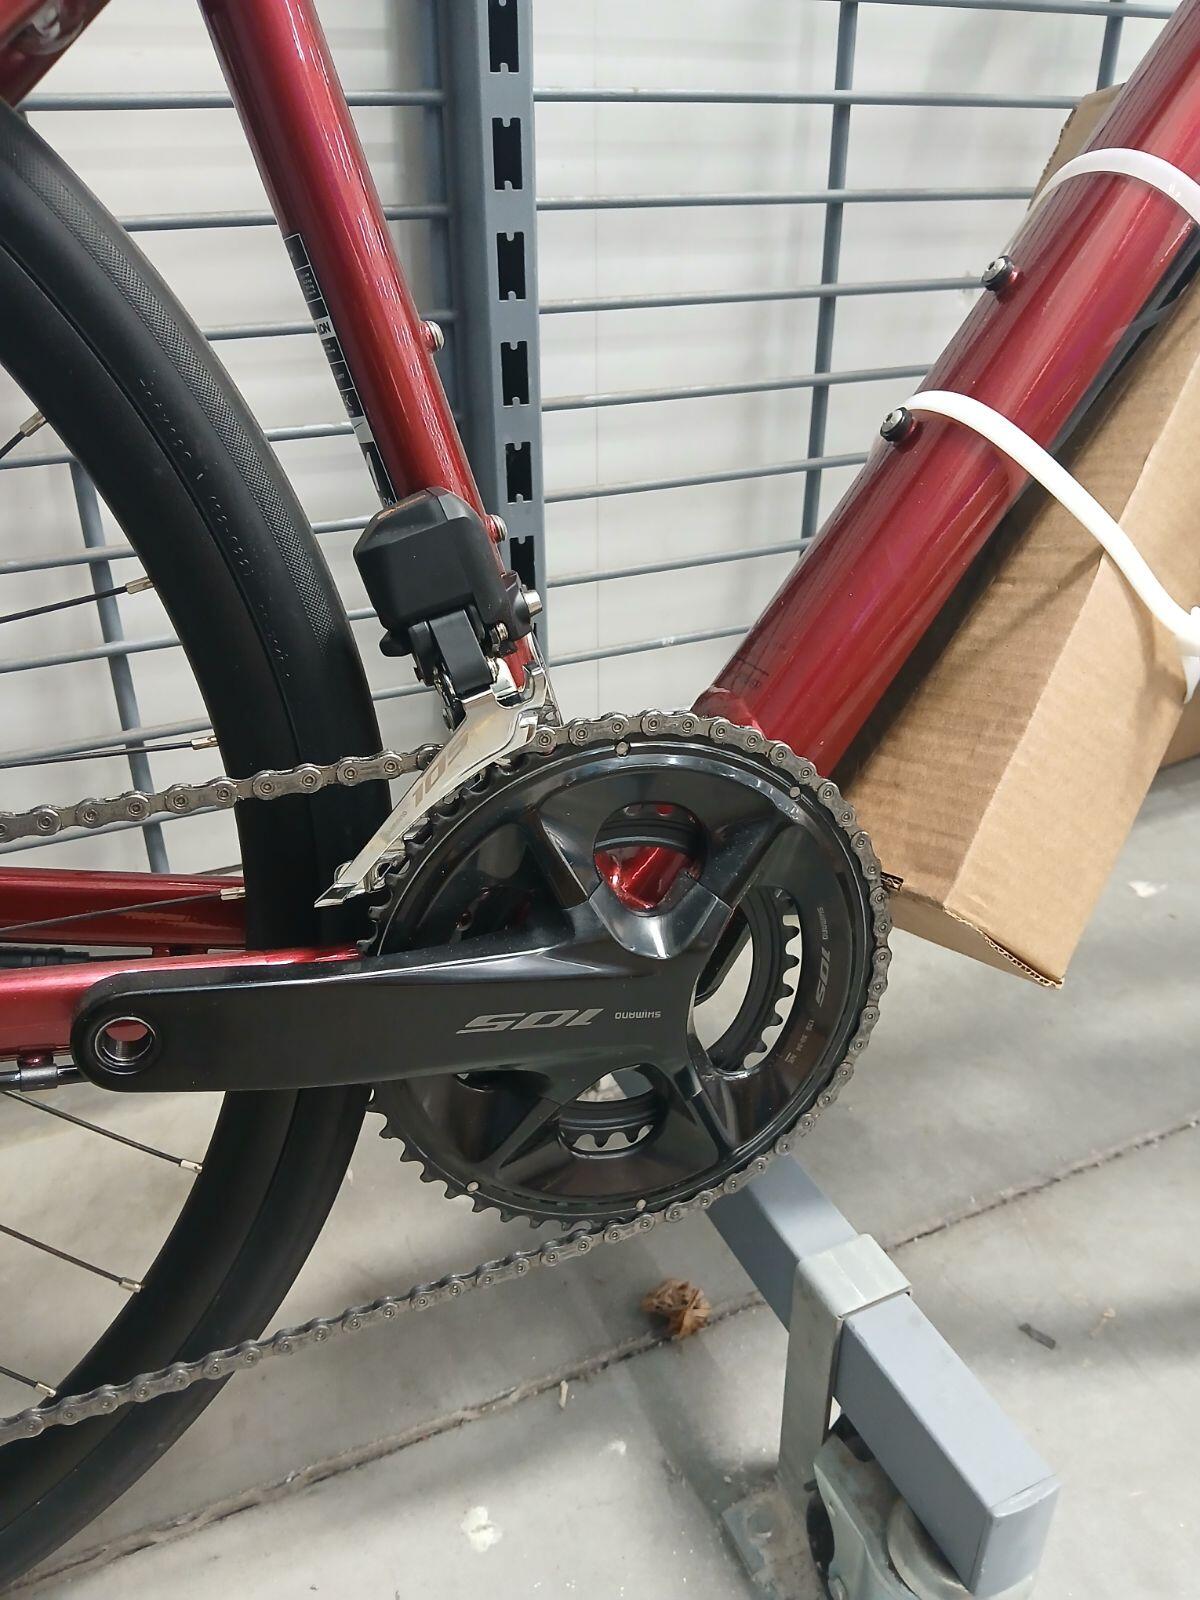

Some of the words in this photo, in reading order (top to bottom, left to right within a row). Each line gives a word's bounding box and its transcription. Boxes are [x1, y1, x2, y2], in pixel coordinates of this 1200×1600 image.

[816, 946, 831, 1007] 105
[456, 1008, 604, 1034] 105
[614, 1010, 662, 1020] SHIMANO
